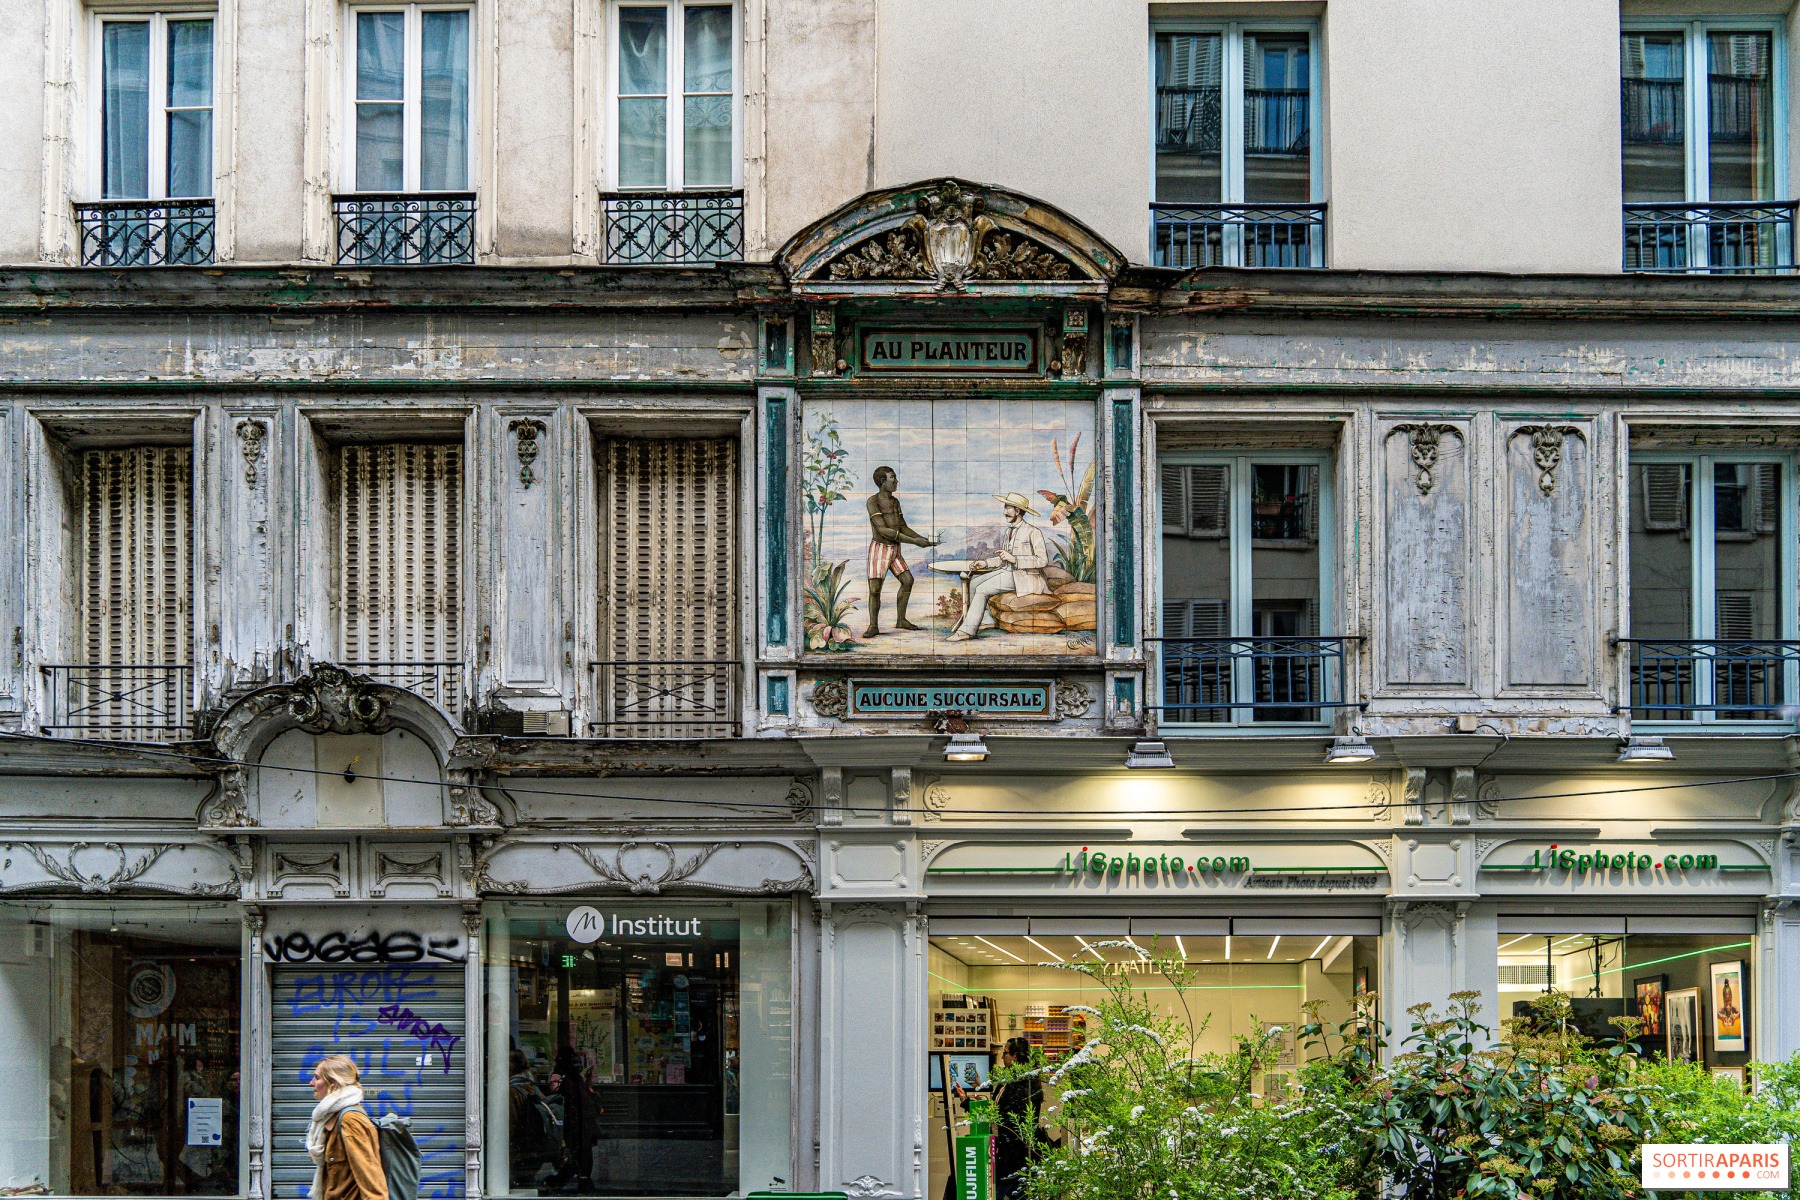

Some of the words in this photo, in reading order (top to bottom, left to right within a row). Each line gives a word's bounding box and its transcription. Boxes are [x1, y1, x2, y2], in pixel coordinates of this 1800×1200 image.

[872, 341, 902, 360] AU
[910, 341, 1028, 361] PLANTEUR
[859, 692, 928, 707] AUCUNE
[932, 692, 1042, 707] SUCCURSALE
[1243, 875, 1283, 889] Artisan
[1285, 875, 1316, 889] Photo
[1317, 875, 1351, 892] depuis
[1351, 875, 1378, 889] 1969
[612, 913, 702, 936] Institut
